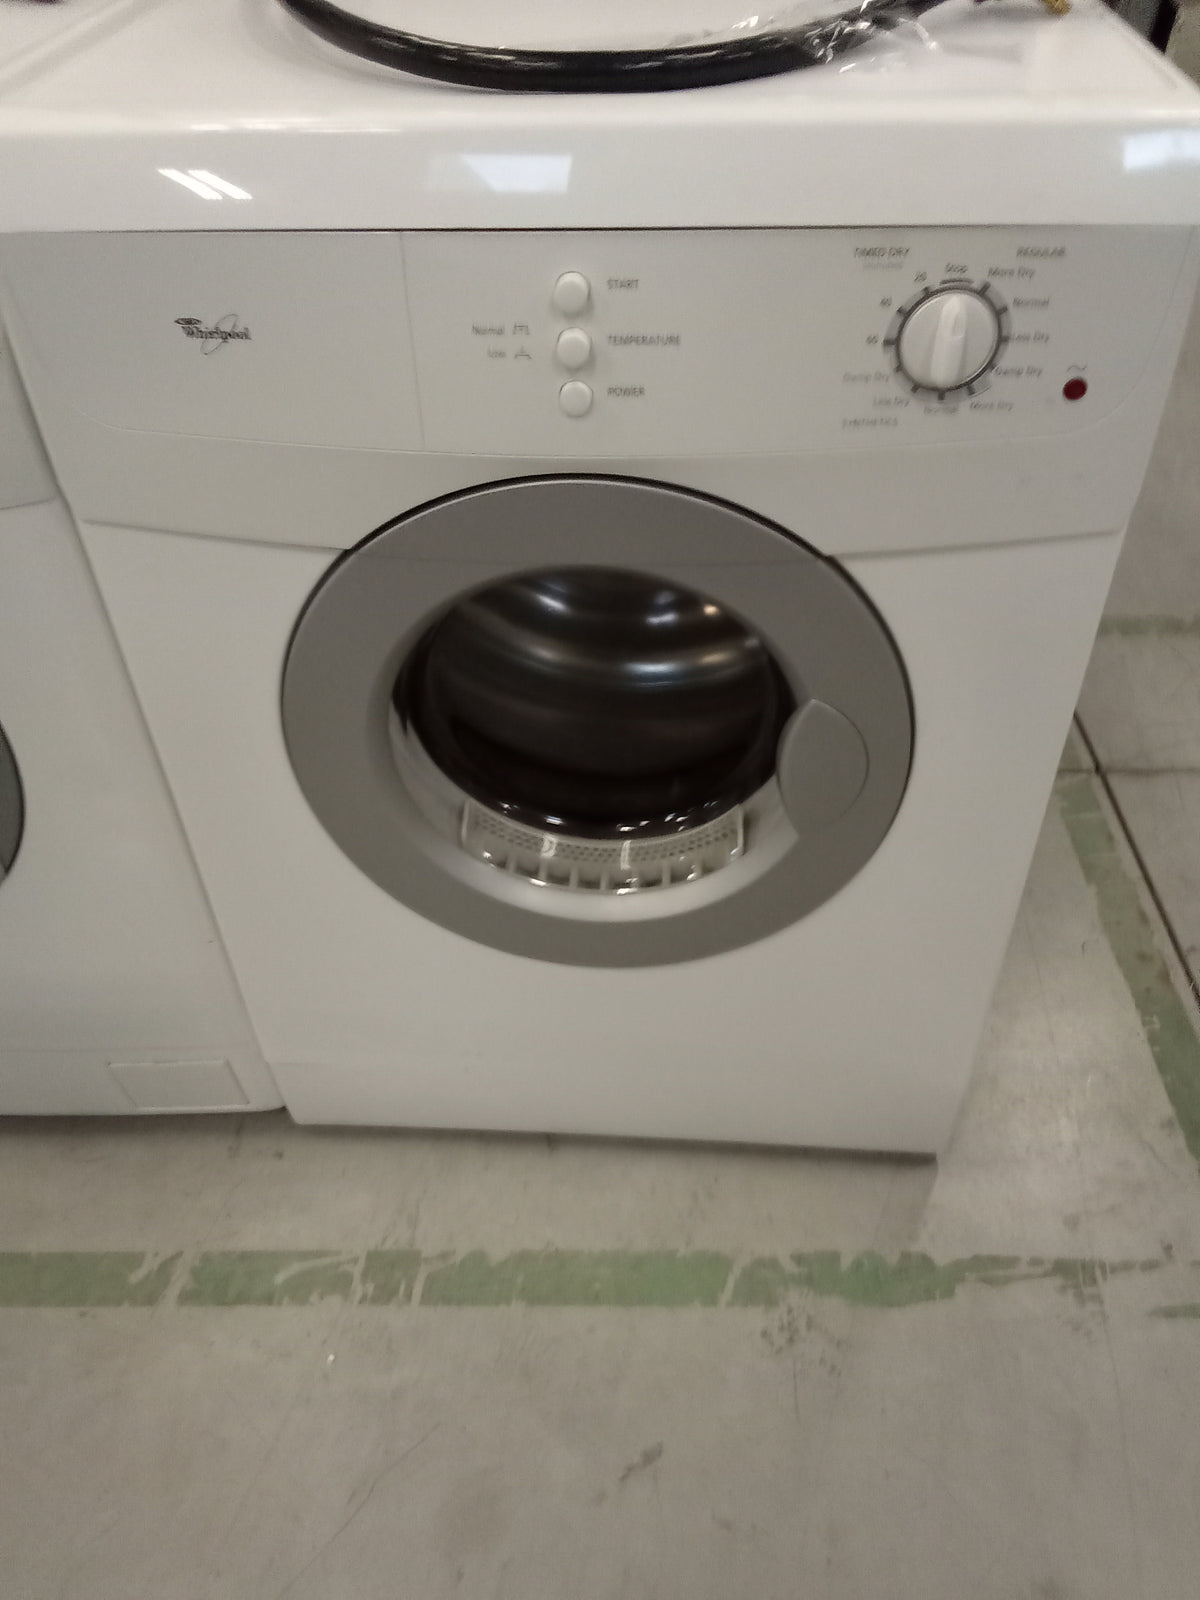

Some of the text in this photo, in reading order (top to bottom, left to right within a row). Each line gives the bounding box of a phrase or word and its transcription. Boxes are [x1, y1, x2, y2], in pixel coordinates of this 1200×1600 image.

[887, 247, 911, 258] DRY
[607, 279, 640, 290] START
[472, 324, 506, 336] Normal
[607, 335, 681, 346] TEMPERATURE
[607, 386, 646, 397] POWER
